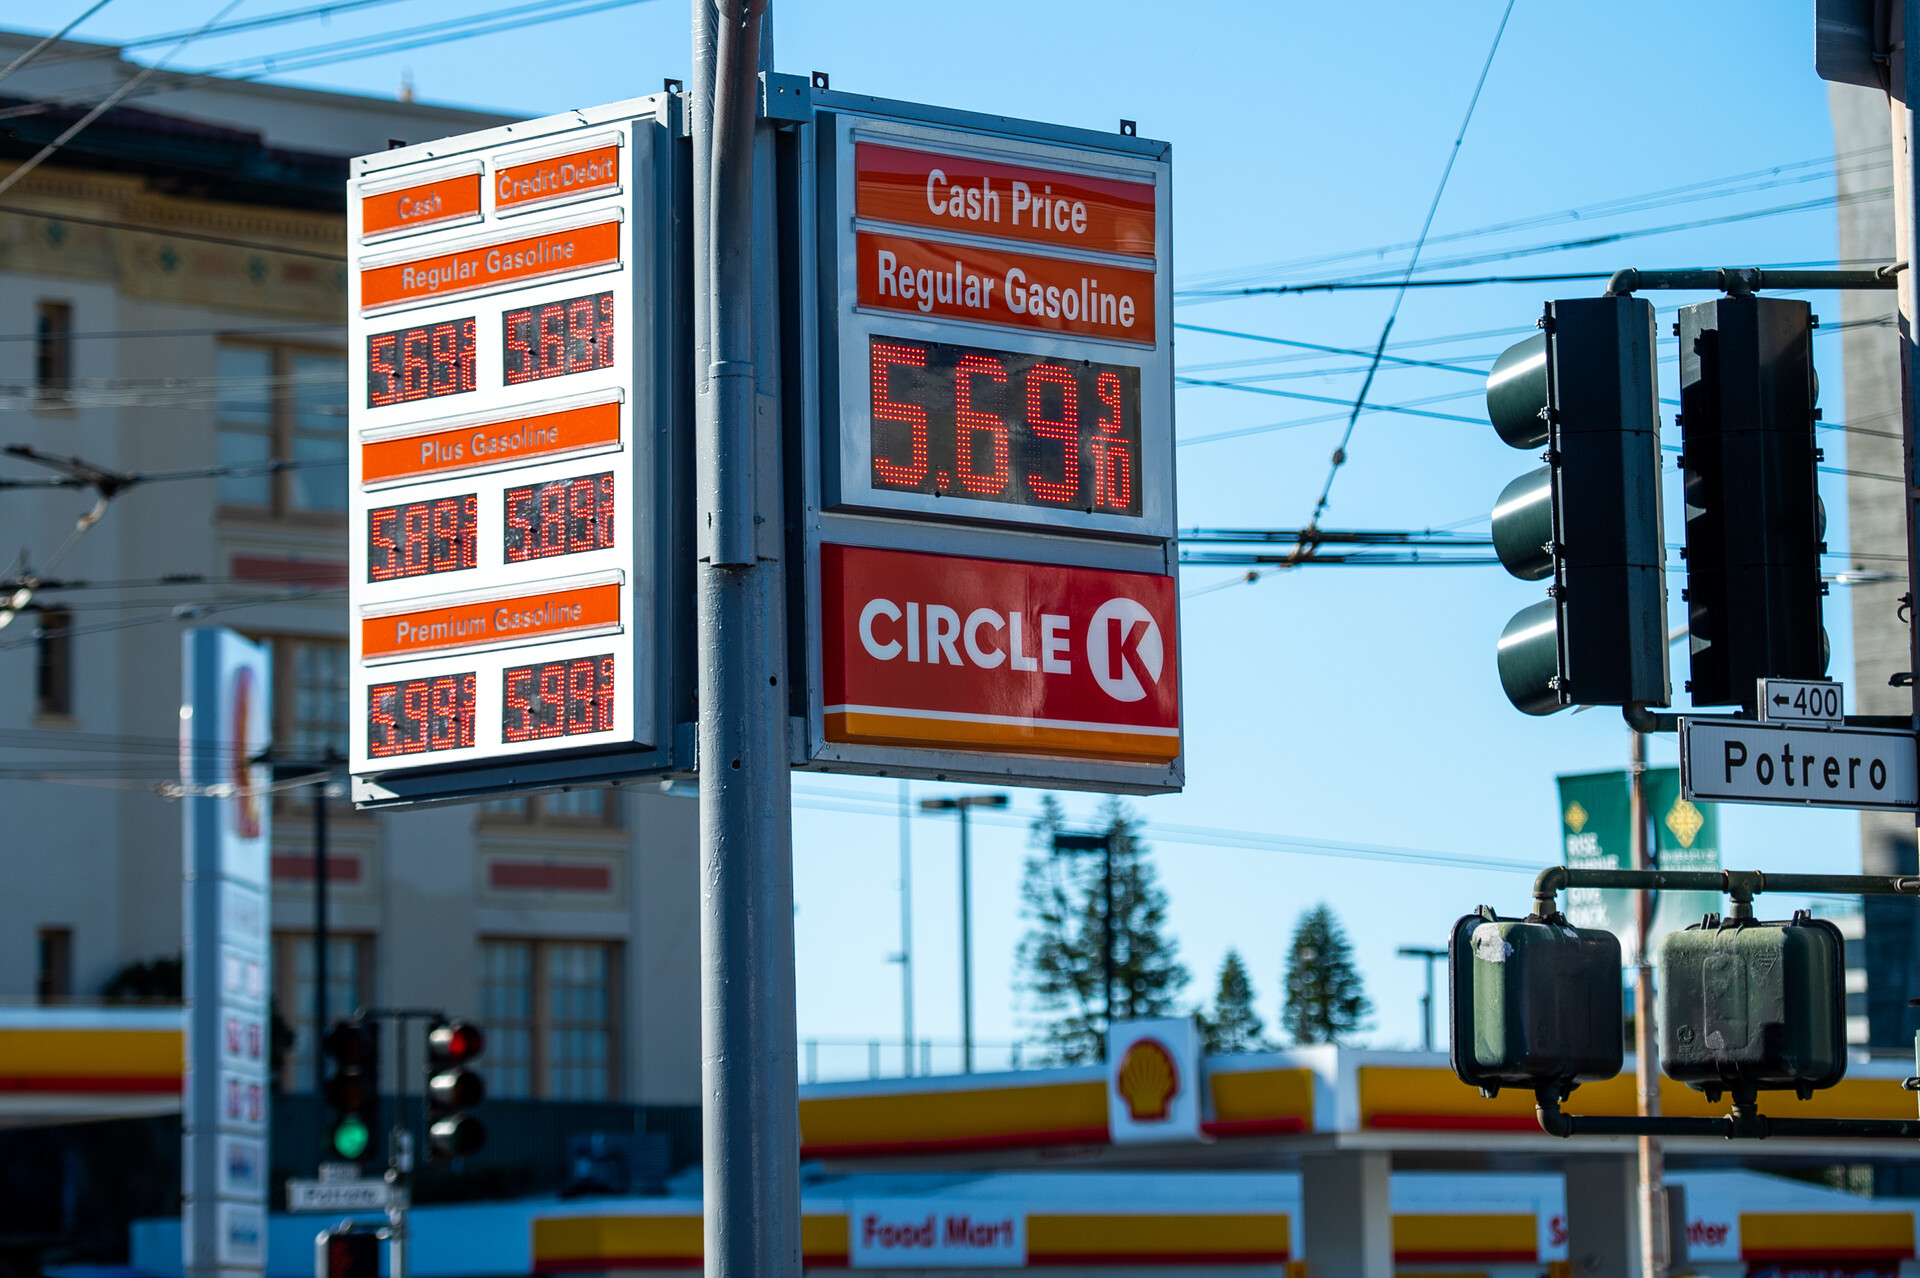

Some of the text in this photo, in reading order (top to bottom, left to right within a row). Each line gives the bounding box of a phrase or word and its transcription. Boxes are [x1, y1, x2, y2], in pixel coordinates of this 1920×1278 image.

[499, 156, 614, 199] Credit/Debit
[397, 191, 442, 220] Cash
[926, 168, 1088, 235] Cash Price
[401, 238, 575, 292] Regular Gasoline
[877, 249, 1136, 328] Regular Gasoline
[420, 423, 559, 466] Plus Gasoline
[395, 600, 583, 645] Premium Gasoline
[858, 597, 1160, 698] CIRCLE K
[1793, 687, 1839, 718] 400
[1724, 739, 1887, 791] Potrero
[862, 1212, 1015, 1249] Food Mart
